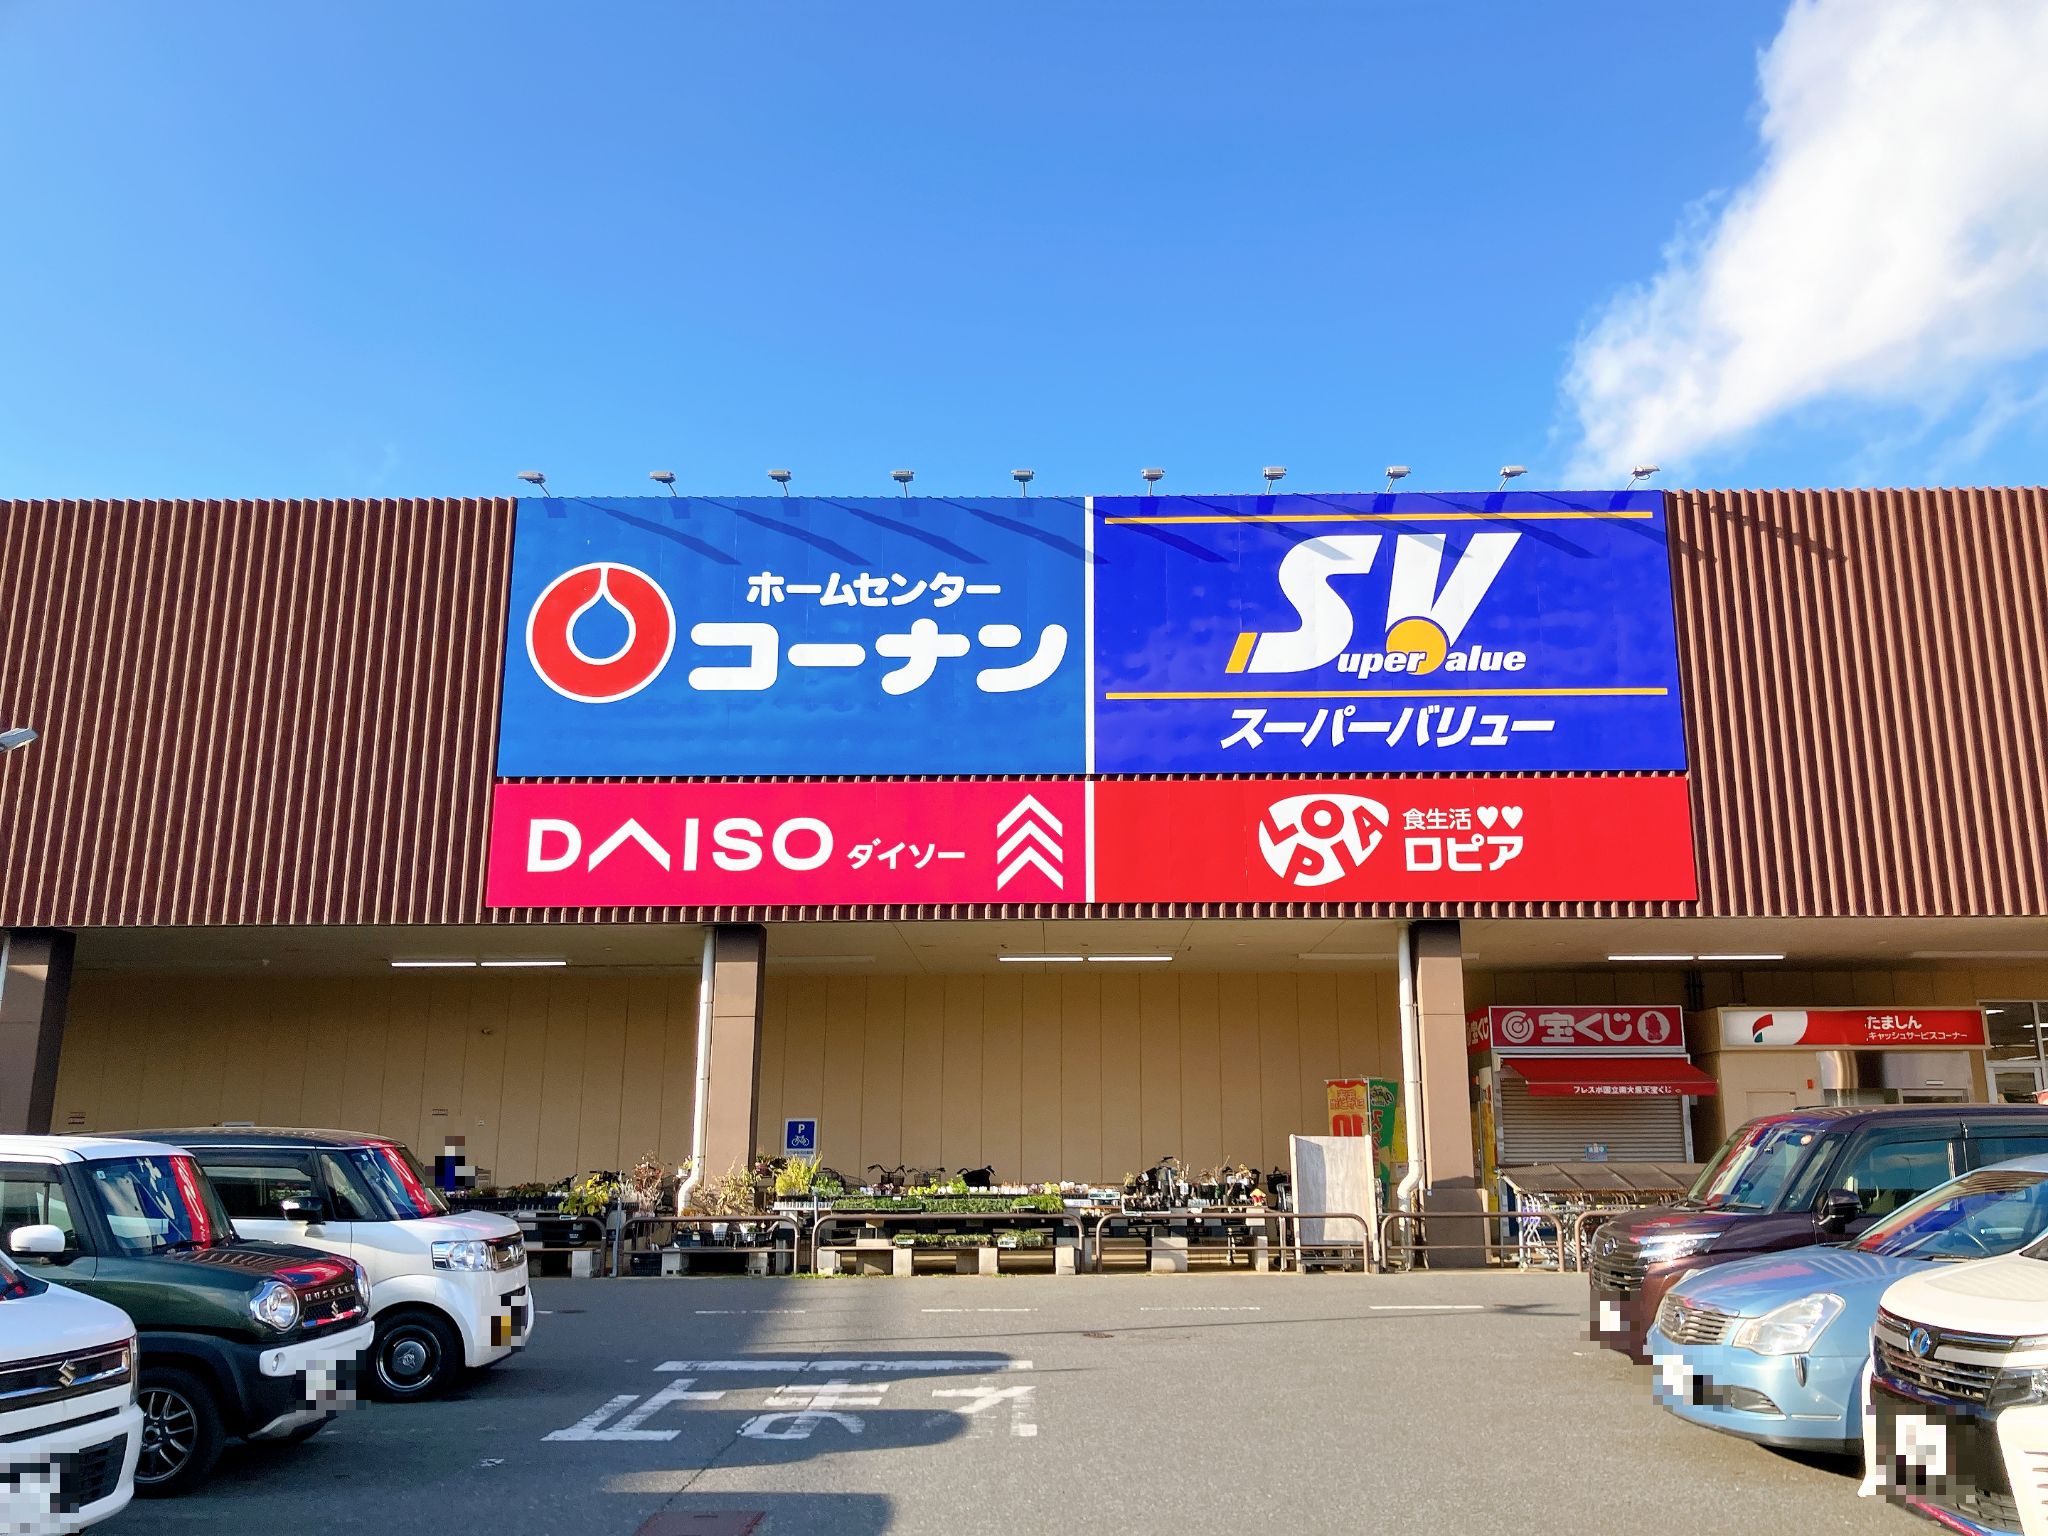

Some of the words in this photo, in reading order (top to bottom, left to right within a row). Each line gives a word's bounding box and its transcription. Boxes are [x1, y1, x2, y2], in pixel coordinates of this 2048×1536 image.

[747, 572, 1001, 607] ホームセンター
[688, 618, 1068, 696] コーナン
[1220, 704, 1556, 750] スーパーバリュー
[1403, 807, 1472, 831] 食生活
[526, 817, 834, 873] DAISO
[847, 838, 966, 870] ダイソー
[1404, 836, 1524, 872] ロピア
[1538, 1012, 1633, 1043] 宝くじ
[1866, 1015, 1922, 1030] たましん
[1868, 1031, 1968, 1041] キャッシュサービスコーナー
[798, 1123, 806, 1134] P
